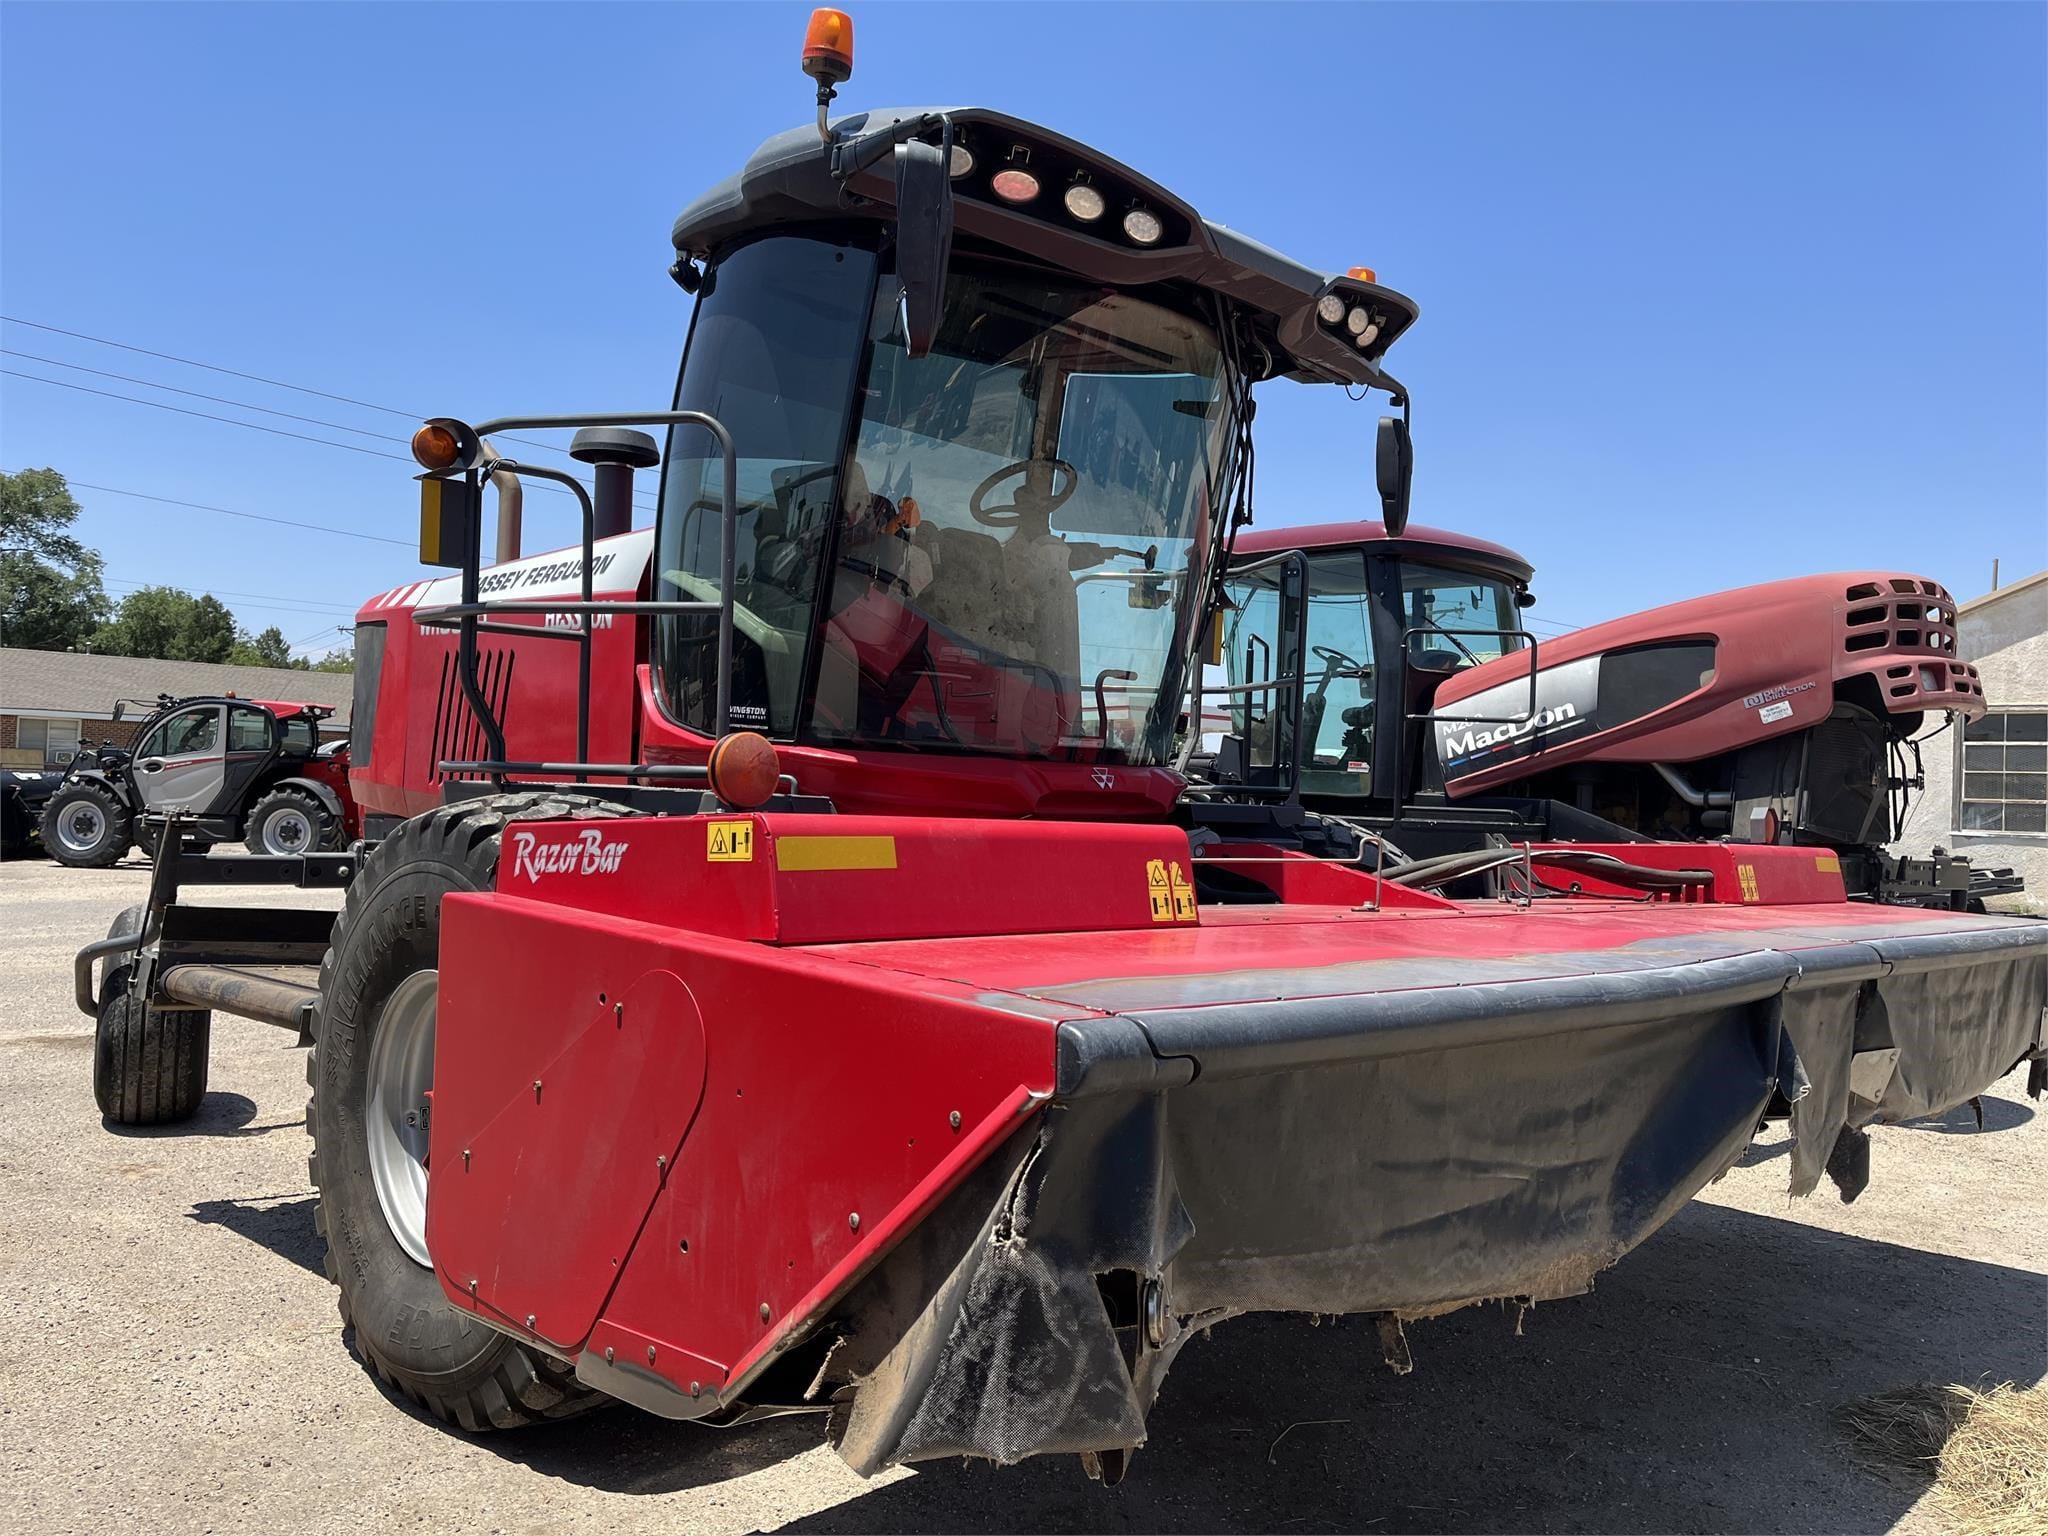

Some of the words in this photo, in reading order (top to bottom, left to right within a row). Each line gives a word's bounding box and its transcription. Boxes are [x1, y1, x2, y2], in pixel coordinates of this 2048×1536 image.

[463, 569, 526, 597] ASSEY
[543, 600, 615, 630] HESSON
[729, 705, 767, 715] VINGSTON
[1445, 703, 1576, 759] MacDon
[513, 829, 629, 884] RazorBar
[329, 893, 428, 1071] ALLIANCE
